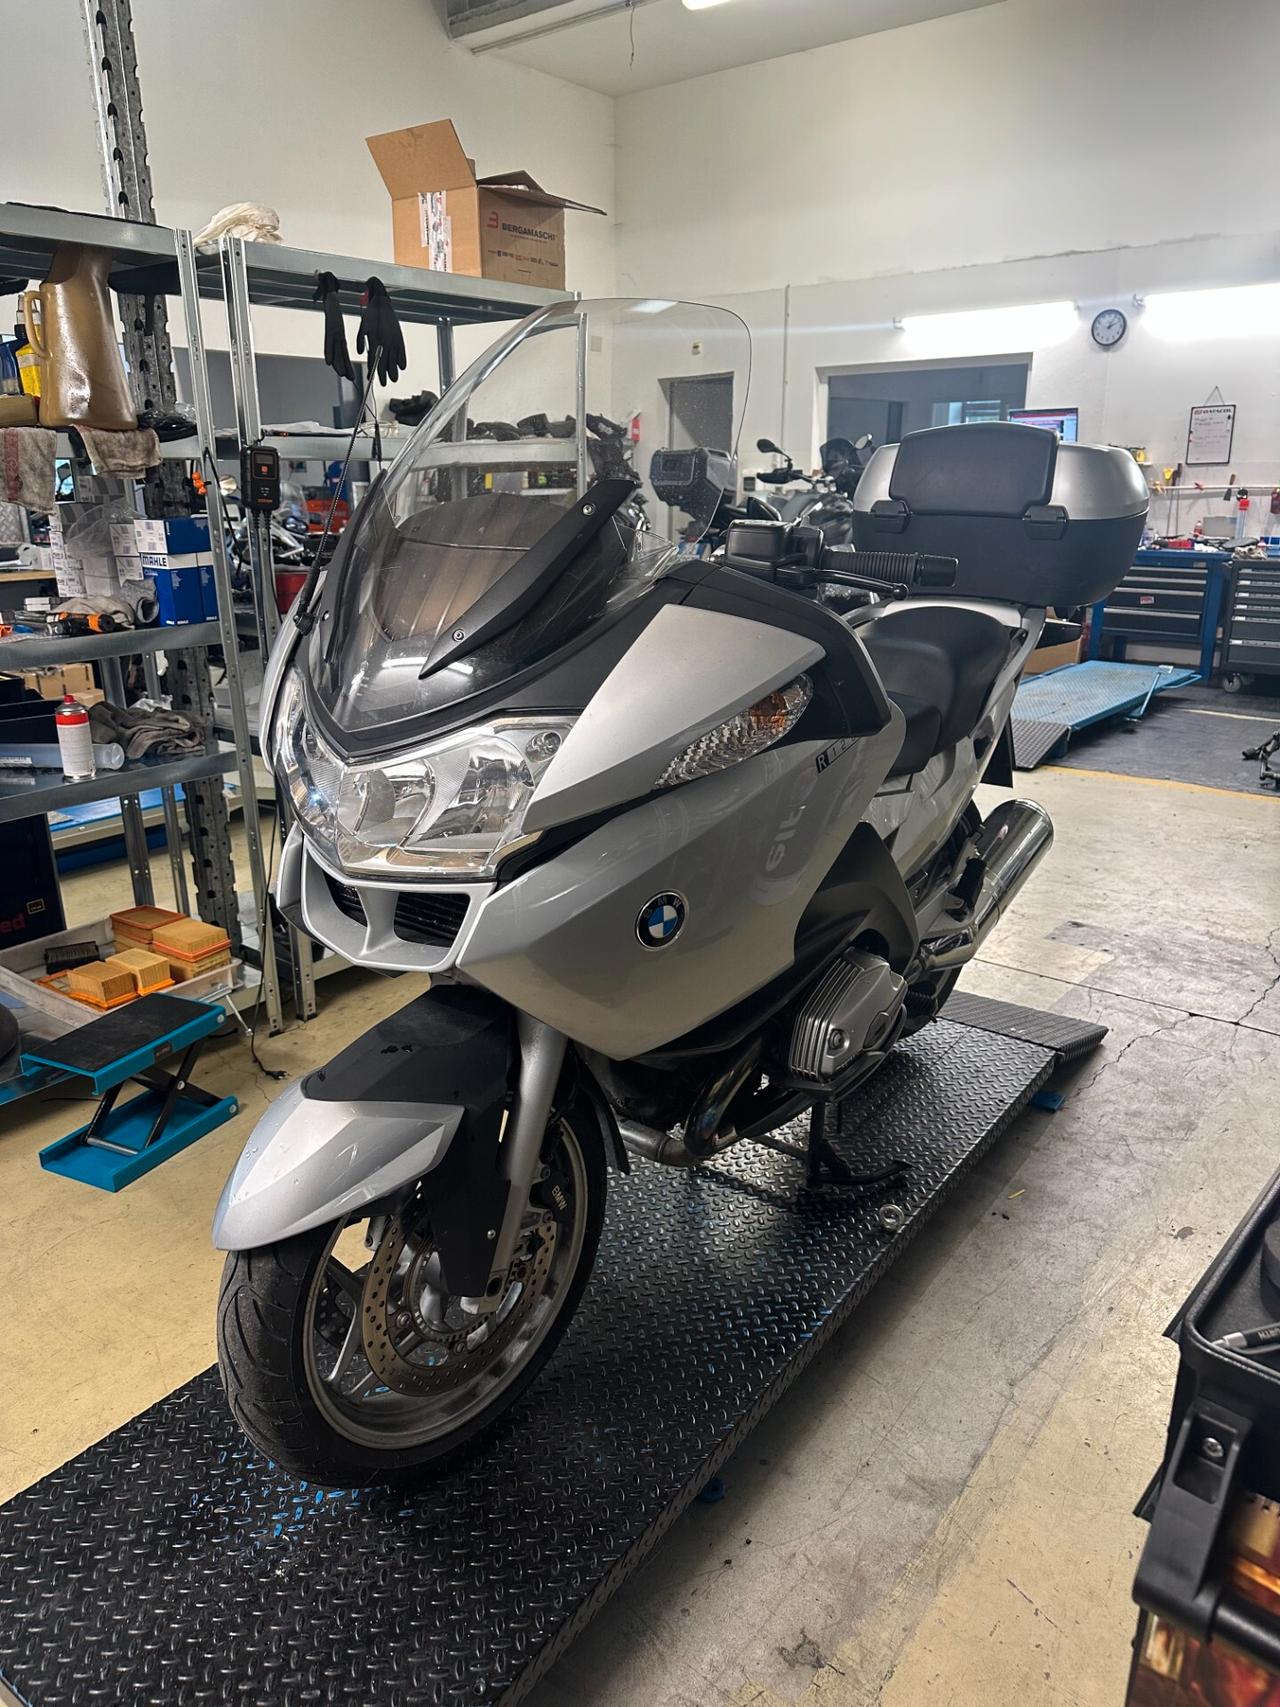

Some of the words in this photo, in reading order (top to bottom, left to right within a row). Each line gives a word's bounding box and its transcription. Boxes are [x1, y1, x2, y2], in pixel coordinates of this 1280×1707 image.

[502, 222, 556, 241] BERGAMASCHI
[142, 555, 168, 567] MAHLE
[551, 1184, 568, 1210] BMW
